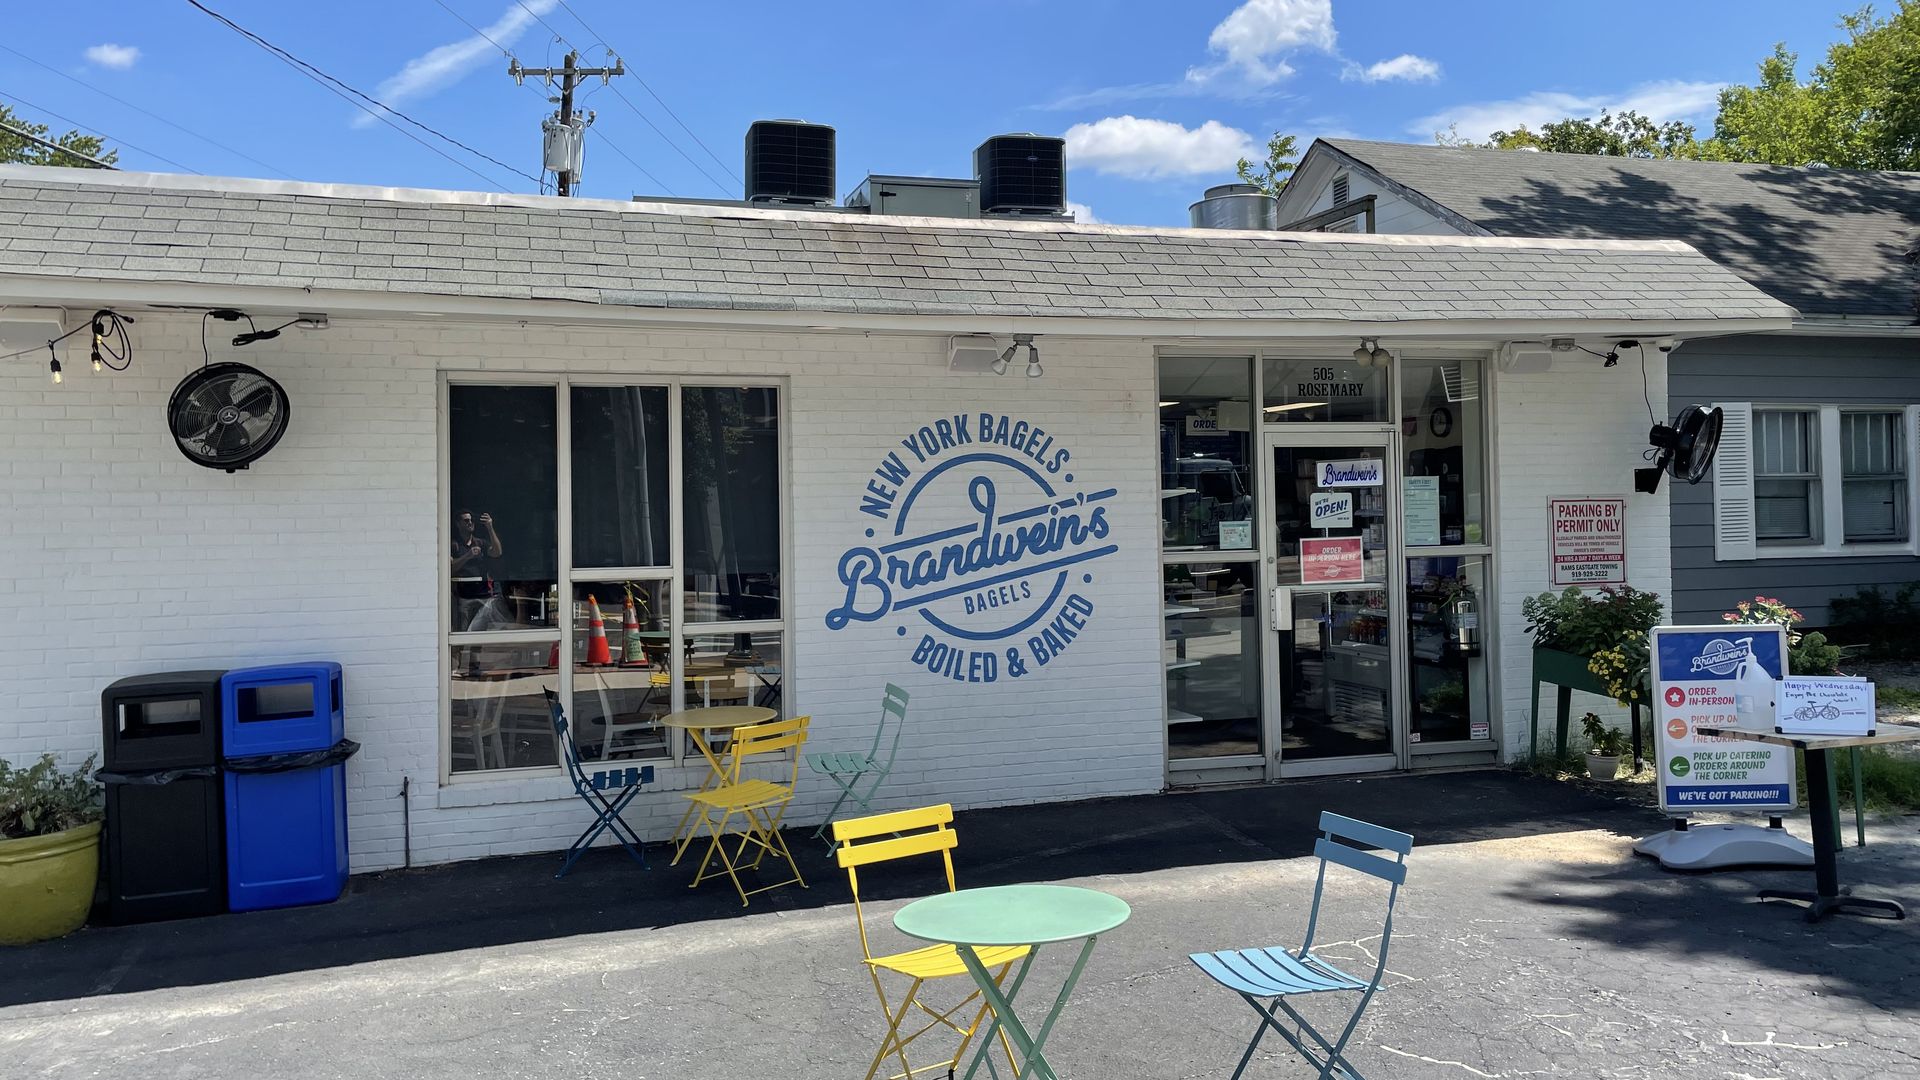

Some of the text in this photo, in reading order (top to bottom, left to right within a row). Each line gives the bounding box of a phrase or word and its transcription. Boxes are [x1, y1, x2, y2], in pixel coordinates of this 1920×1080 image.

[1313, 367, 1334, 380] 505
[1298, 383, 1364, 396] ROSEMARY
[1192, 419, 1217, 429] ORDE
[859, 413, 1070, 520] NEW YORK BAGELS
[1322, 463, 1378, 485] Brandwein's
[1315, 499, 1348, 517] OPEN!
[1558, 504, 1618, 518] PARKING BY
[1556, 519, 1621, 533] PERMIT ONLY
[825, 476, 1110, 630] Brandwein's
[1322, 546, 1342, 554] ORDER
[964, 580, 1031, 615] BAGELS
[911, 593, 1094, 683] BOILED & BAKED
[1688, 687, 1717, 696] ORDER
[1784, 682, 1812, 691] Happy
[1689, 697, 1735, 706] IN-PERSON
[1691, 715, 1711, 724] PICK
[1712, 715, 1724, 723] UP
[1692, 735, 1708, 744] THE
[1693, 750, 1772, 760] PICK UP CATERING
[1694, 761, 1766, 770] ORDERS AROUND
[1694, 771, 1748, 780] THE CORNER
[1679, 790, 1780, 800] WE'VE GOT PARKING!!!
